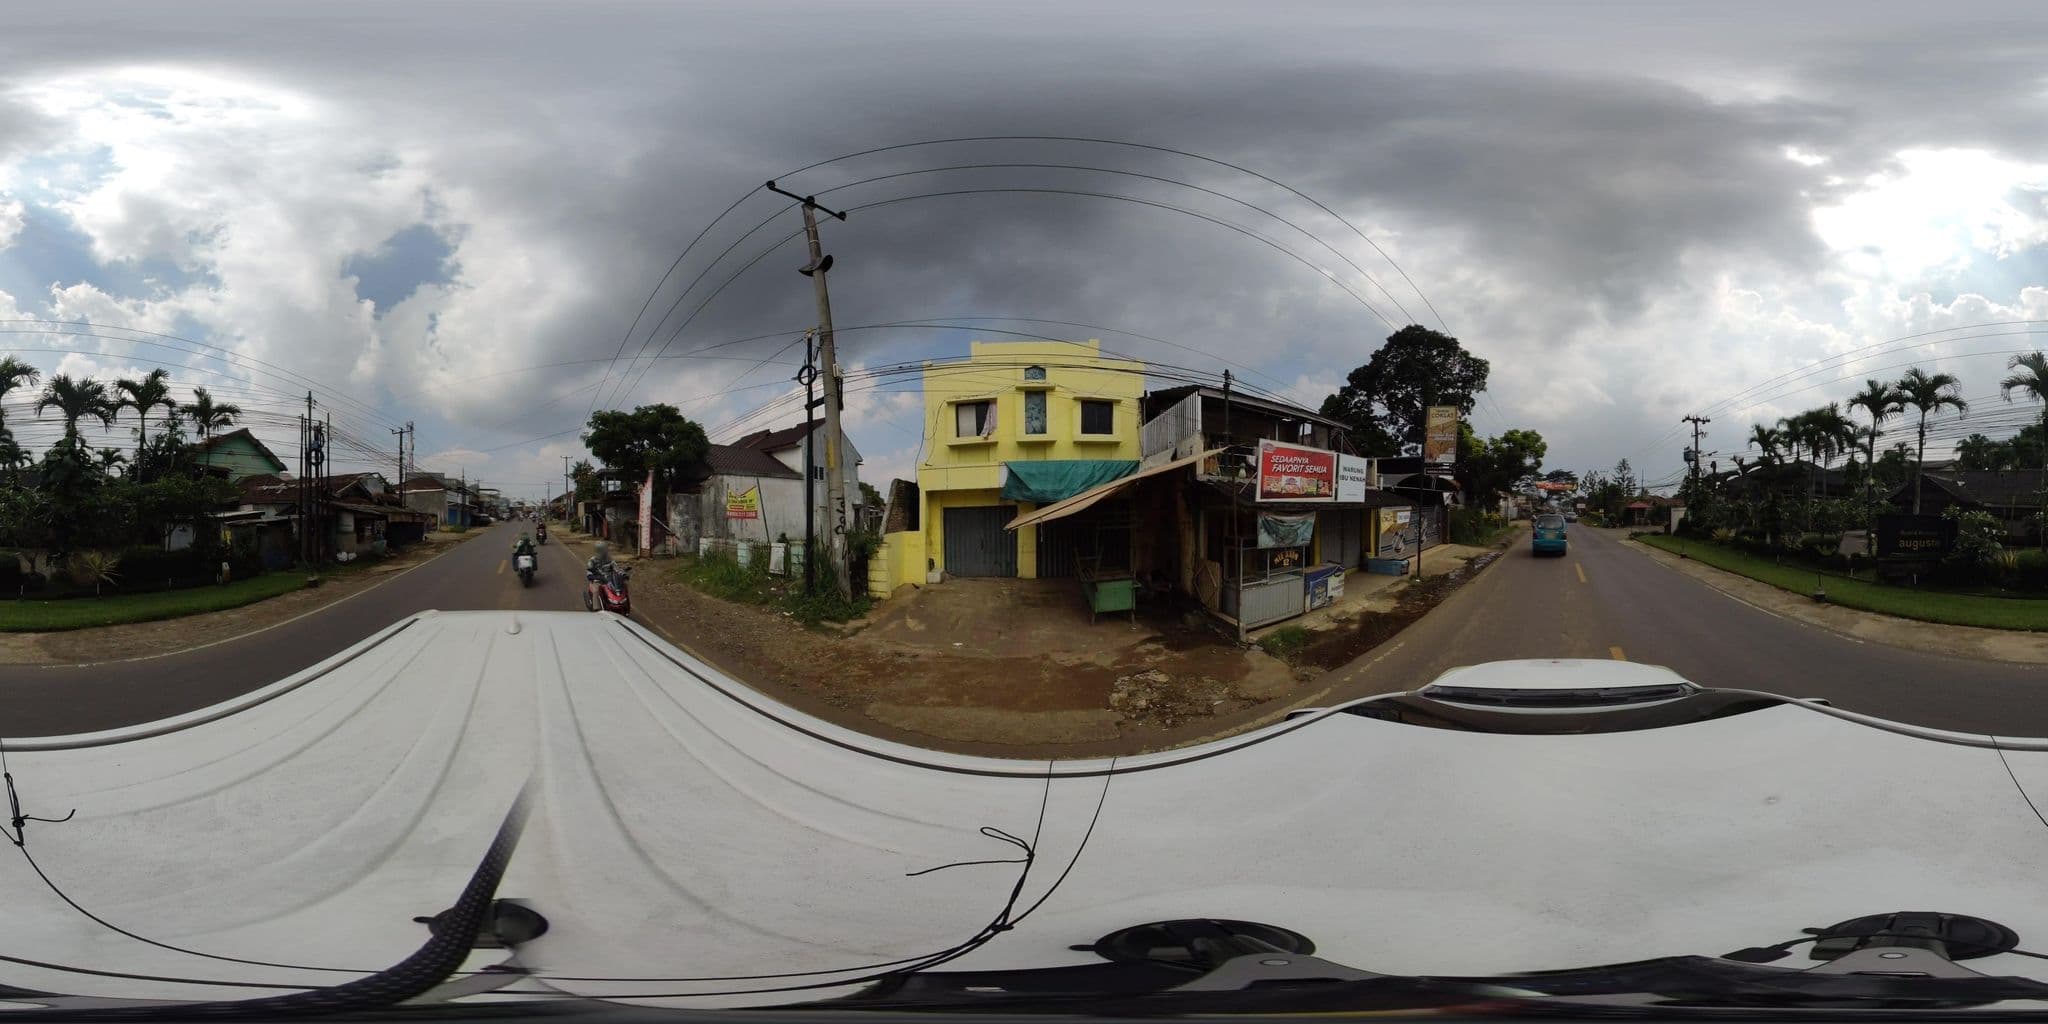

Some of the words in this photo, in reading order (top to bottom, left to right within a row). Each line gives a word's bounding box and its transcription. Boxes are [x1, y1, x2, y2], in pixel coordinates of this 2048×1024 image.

[1270, 455, 1309, 464] SEDAAPNYA
[1271, 463, 1305, 473] FAVORIT
[1304, 464, 1327, 474] SEMUA
[1343, 466, 1364, 474] WARUNG
